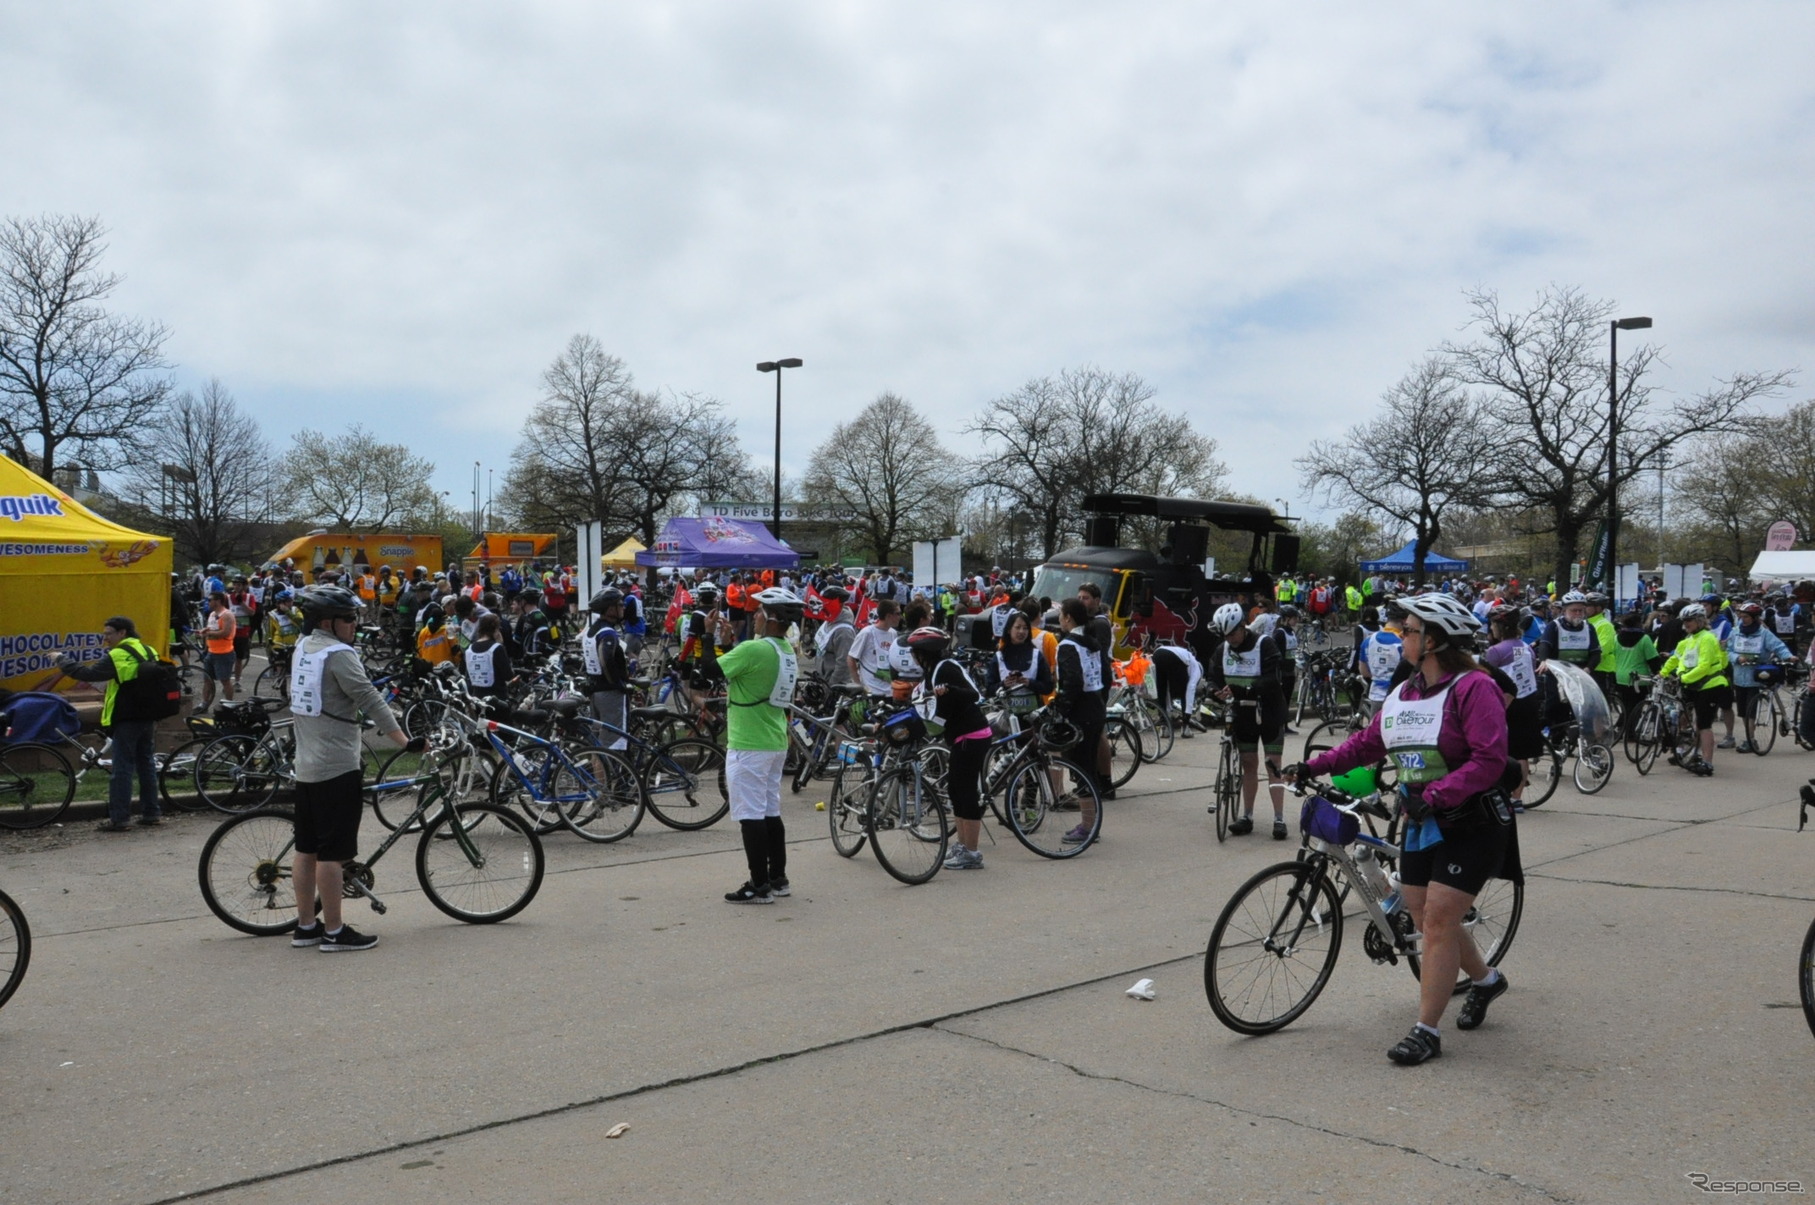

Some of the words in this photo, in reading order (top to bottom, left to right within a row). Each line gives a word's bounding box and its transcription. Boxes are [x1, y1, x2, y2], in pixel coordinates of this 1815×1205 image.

[711, 506, 728, 516] TD
[733, 506, 758, 517] Five
[0, 543, 88, 556] ESOMENESS
[1593, 560, 1604, 578] Giro
